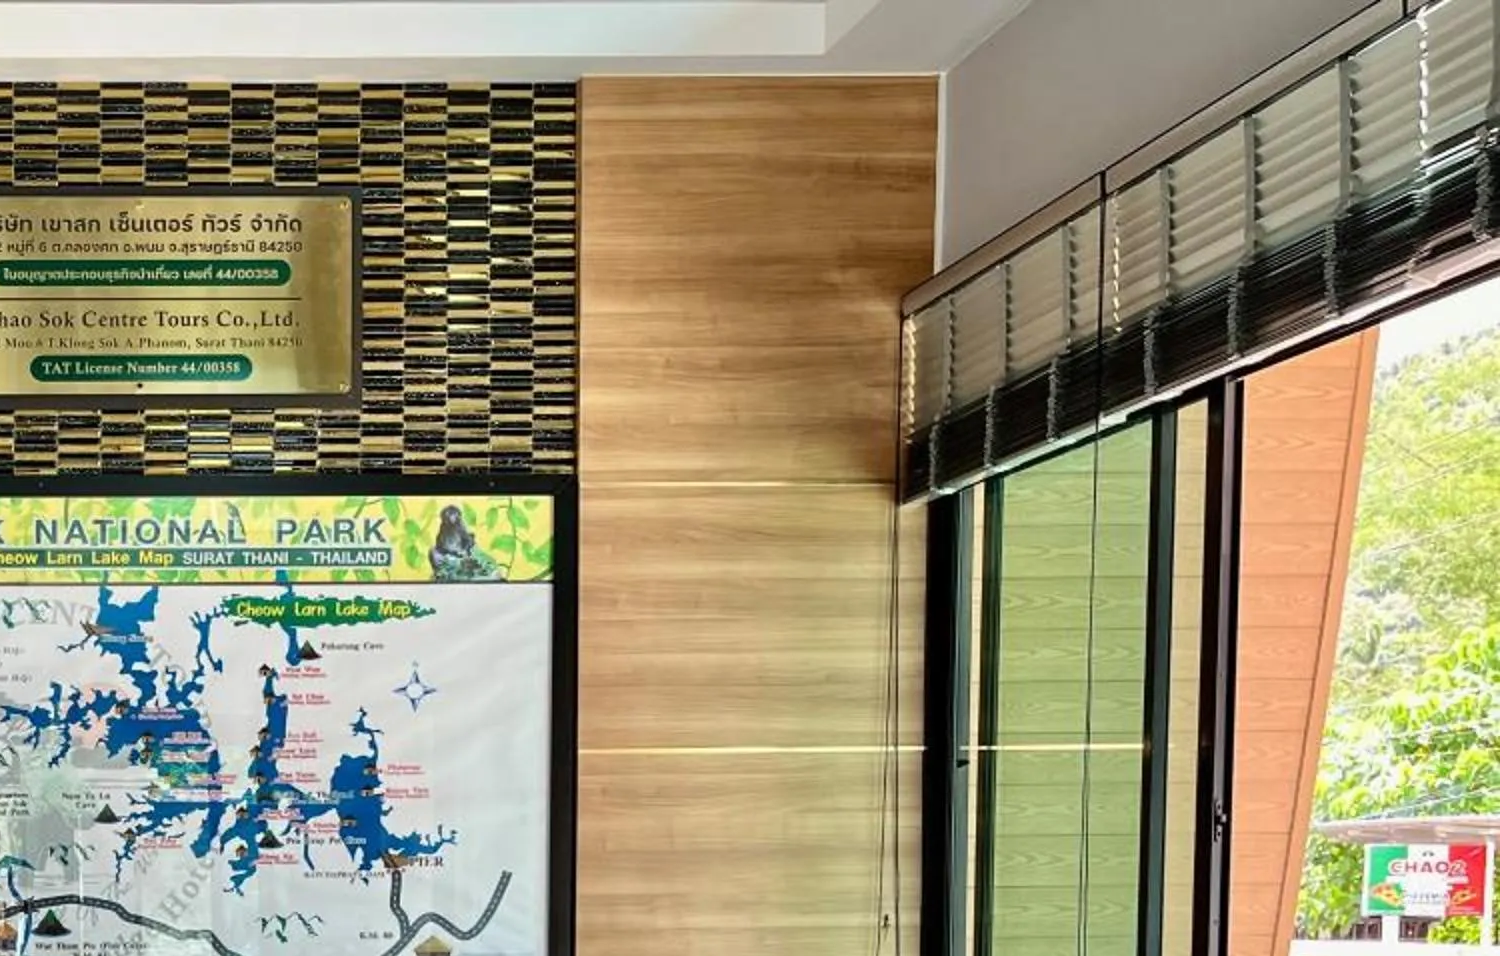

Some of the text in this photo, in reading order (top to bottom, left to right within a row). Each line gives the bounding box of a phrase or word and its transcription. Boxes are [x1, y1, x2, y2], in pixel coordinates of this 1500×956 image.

[41, 217, 101, 233] เขาสก
[109, 211, 195, 233] เซ็นเตอร์
[202, 213, 243, 233] ทัวร์
[251, 213, 303, 233] จำกัด
[259, 241, 303, 253] 84250
[39, 311, 75, 328] Sok
[82, 310, 148, 328] Centre
[154, 310, 209, 328] Tours
[41, 361, 72, 374] TAT
[75, 361, 123, 374] License
[126, 361, 178, 374] Number
[35, 518, 246, 545] NATIONAL
[275, 518, 387, 544] PARK
[48, 550, 83, 565] Larn
[92, 550, 130, 565] Lake
[139, 550, 174, 566] Map
[183, 550, 235, 565] SURAT
[242, 550, 289, 565] THANI
[311, 550, 388, 564] THAILAND
[236, 601, 411, 619] Cheow Larn Lake Map
